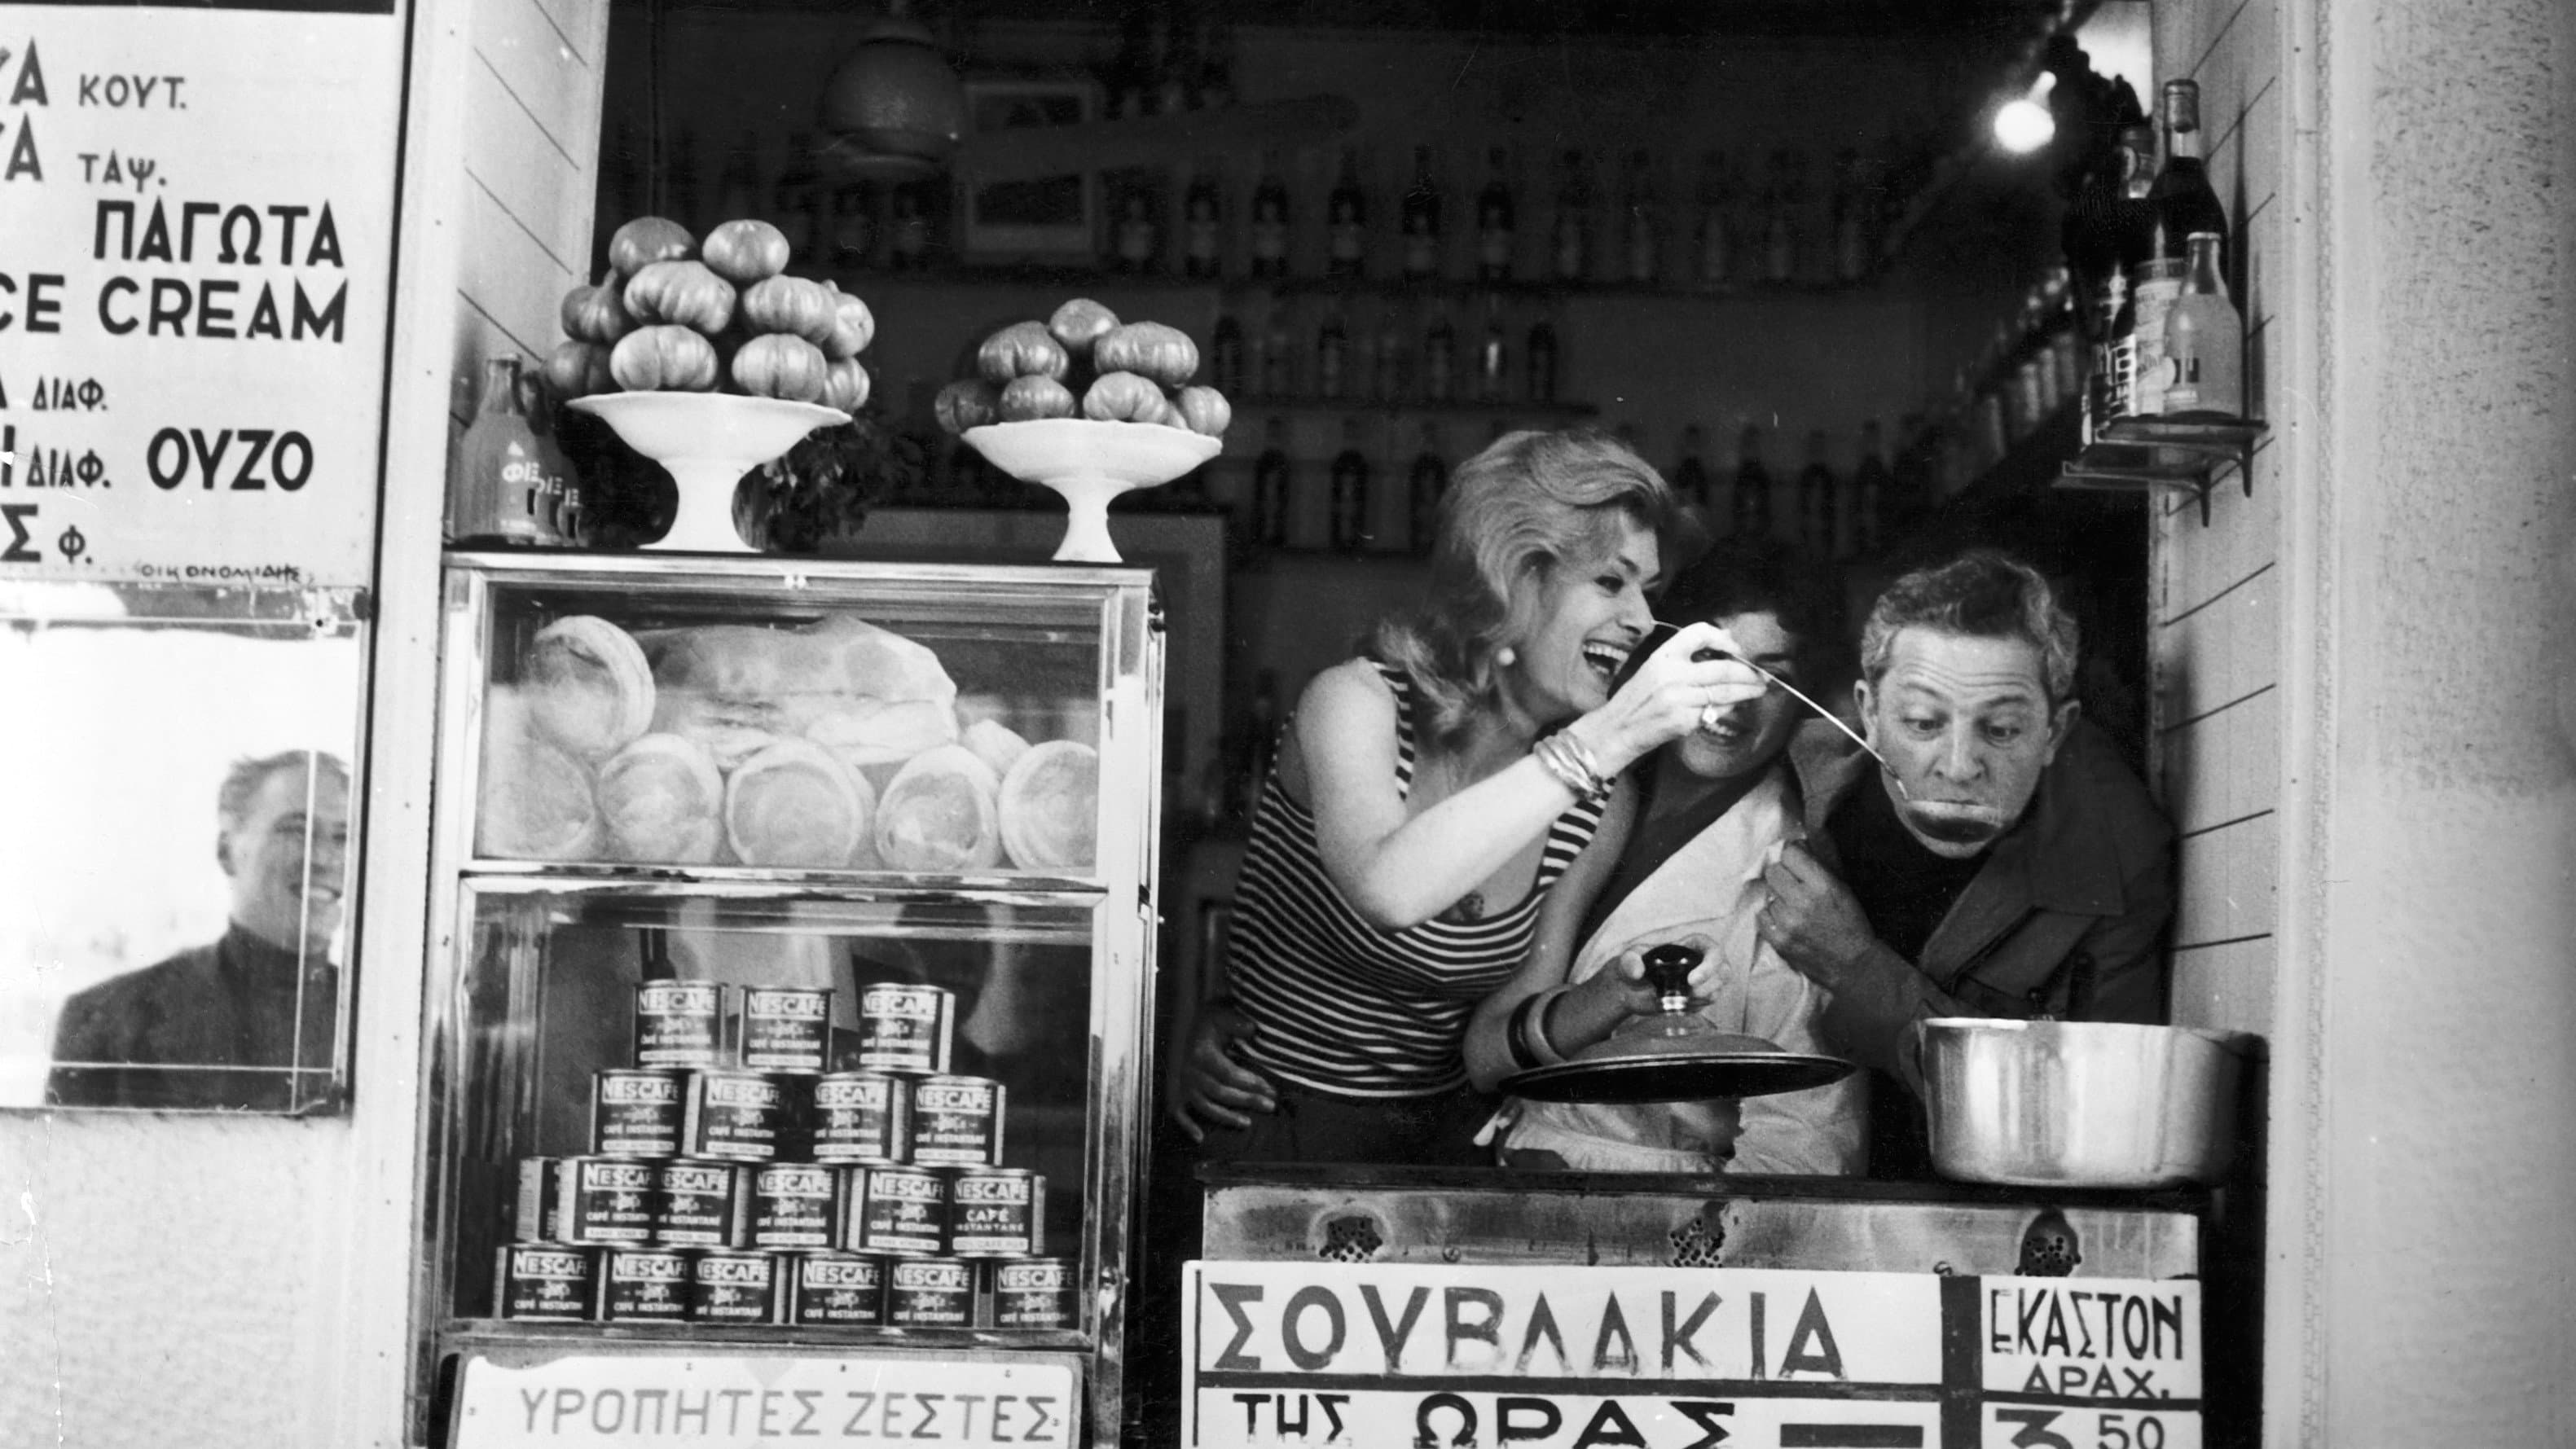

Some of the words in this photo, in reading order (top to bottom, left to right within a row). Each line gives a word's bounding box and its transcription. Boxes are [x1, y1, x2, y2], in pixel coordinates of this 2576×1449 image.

[0, 36, 49, 107] Α
[79, 74, 187, 109] ΚΟΥΤ.
[0, 111, 43, 182] Α
[77, 150, 167, 193] ΤΑΨ.
[94, 195, 344, 268] ΠΑΓΩΤΑ
[99, 275, 349, 343] CREAM
[33, 375, 108, 411] ΔΙΑΦ.
[27, 444, 111, 488] ΔΙΑΦ.
[147, 427, 314, 491] ΟΥΖΟ
[1209, 1282, 1848, 1381] ΣΟΥΒΛΑΚΙΑ
[1991, 1287, 2183, 1361] ΕΚΑΣΤΟΝ
[2022, 1363, 2170, 1398] ΔΡΑΧ.
[842, 1391, 1056, 1442] ΖΕΣΤΕΣ
[1233, 1393, 1352, 1447] ΤΗΣ
[1413, 1392, 1735, 1449] ΩΡΑΣ
